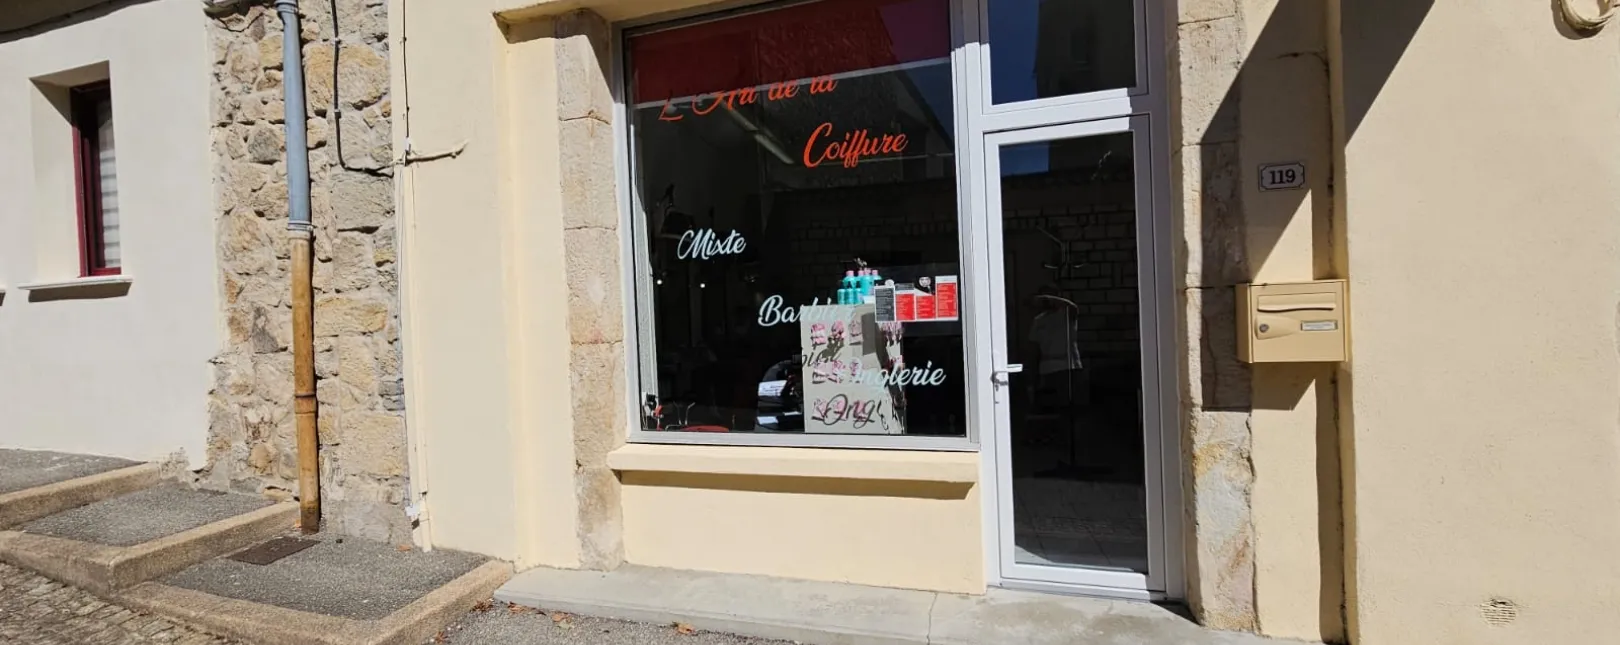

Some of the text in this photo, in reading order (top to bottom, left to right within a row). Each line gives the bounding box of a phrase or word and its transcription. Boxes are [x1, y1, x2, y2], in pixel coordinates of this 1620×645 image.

[658, 87, 758, 121] LArt
[803, 122, 909, 168] Coiffure
[1268, 169, 1296, 185] 119
[677, 228, 747, 260] Mixte
